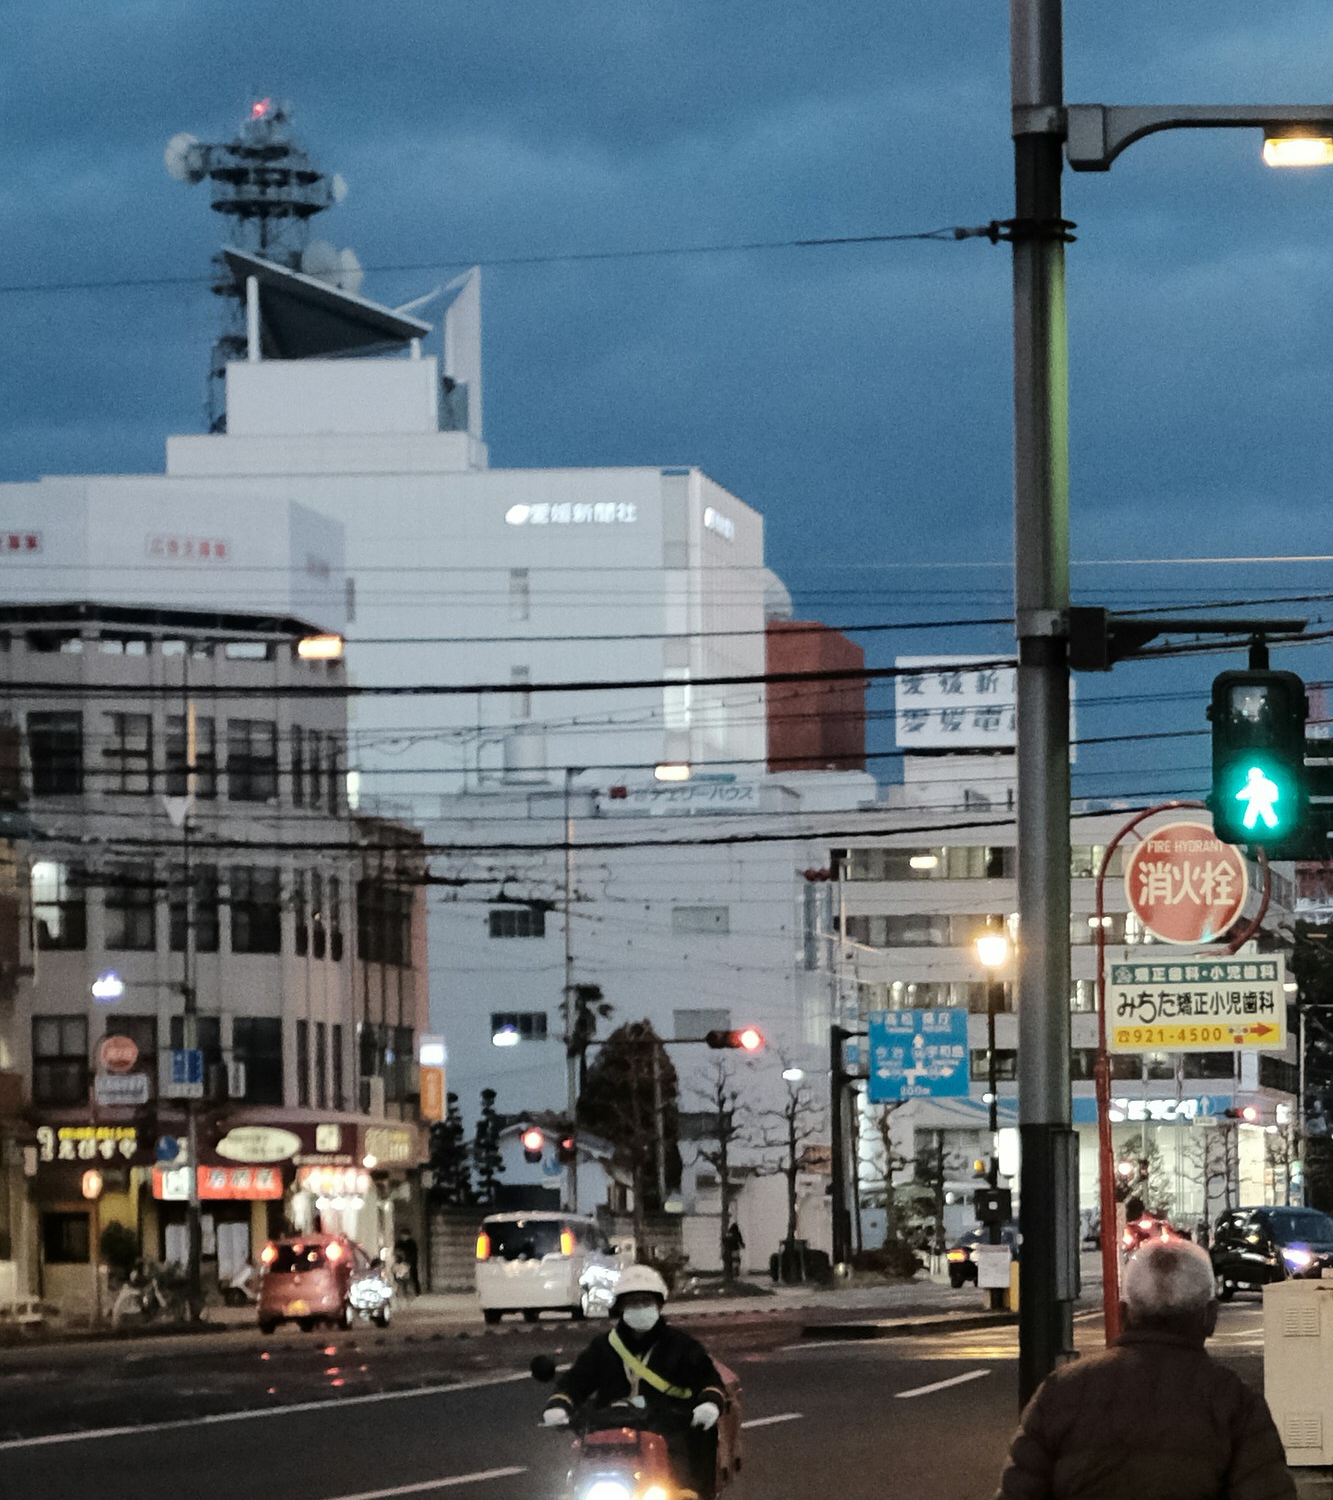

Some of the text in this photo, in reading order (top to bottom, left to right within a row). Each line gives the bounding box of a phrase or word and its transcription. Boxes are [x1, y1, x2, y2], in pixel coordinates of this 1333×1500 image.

[1147, 838, 1224, 853] FIRE HYDRANT
[1138, 860, 1236, 906] 消火栓
[1116, 989, 1275, 1024] みちた矯正小児歯科
[1132, 1027, 1223, 1044] 921-4500
